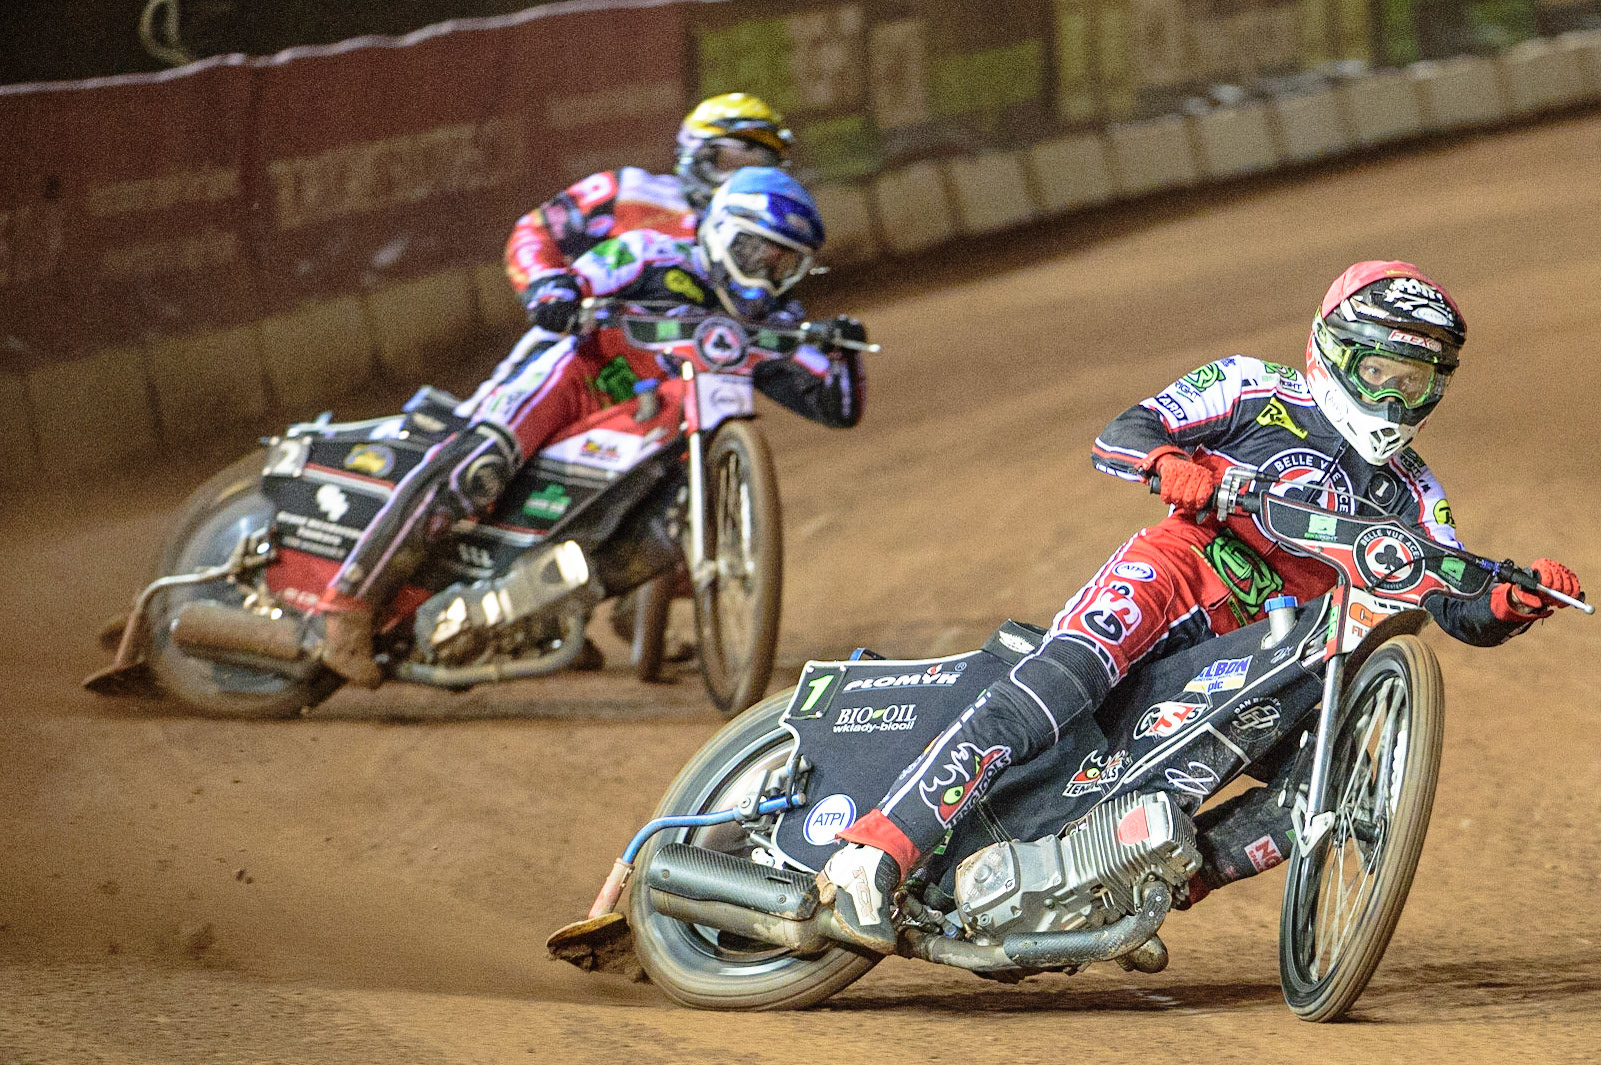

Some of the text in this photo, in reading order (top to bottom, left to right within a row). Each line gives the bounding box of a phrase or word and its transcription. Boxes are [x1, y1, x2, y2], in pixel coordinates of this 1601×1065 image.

[272, 441, 302, 474] 2
[1274, 456, 1314, 473] BELLE
[1361, 529, 1383, 546] BELLE
[1386, 530, 1404, 542] VUE
[800, 674, 835, 712] 1
[835, 704, 918, 725] BIO OIL
[812, 812, 846, 826] ATPI
